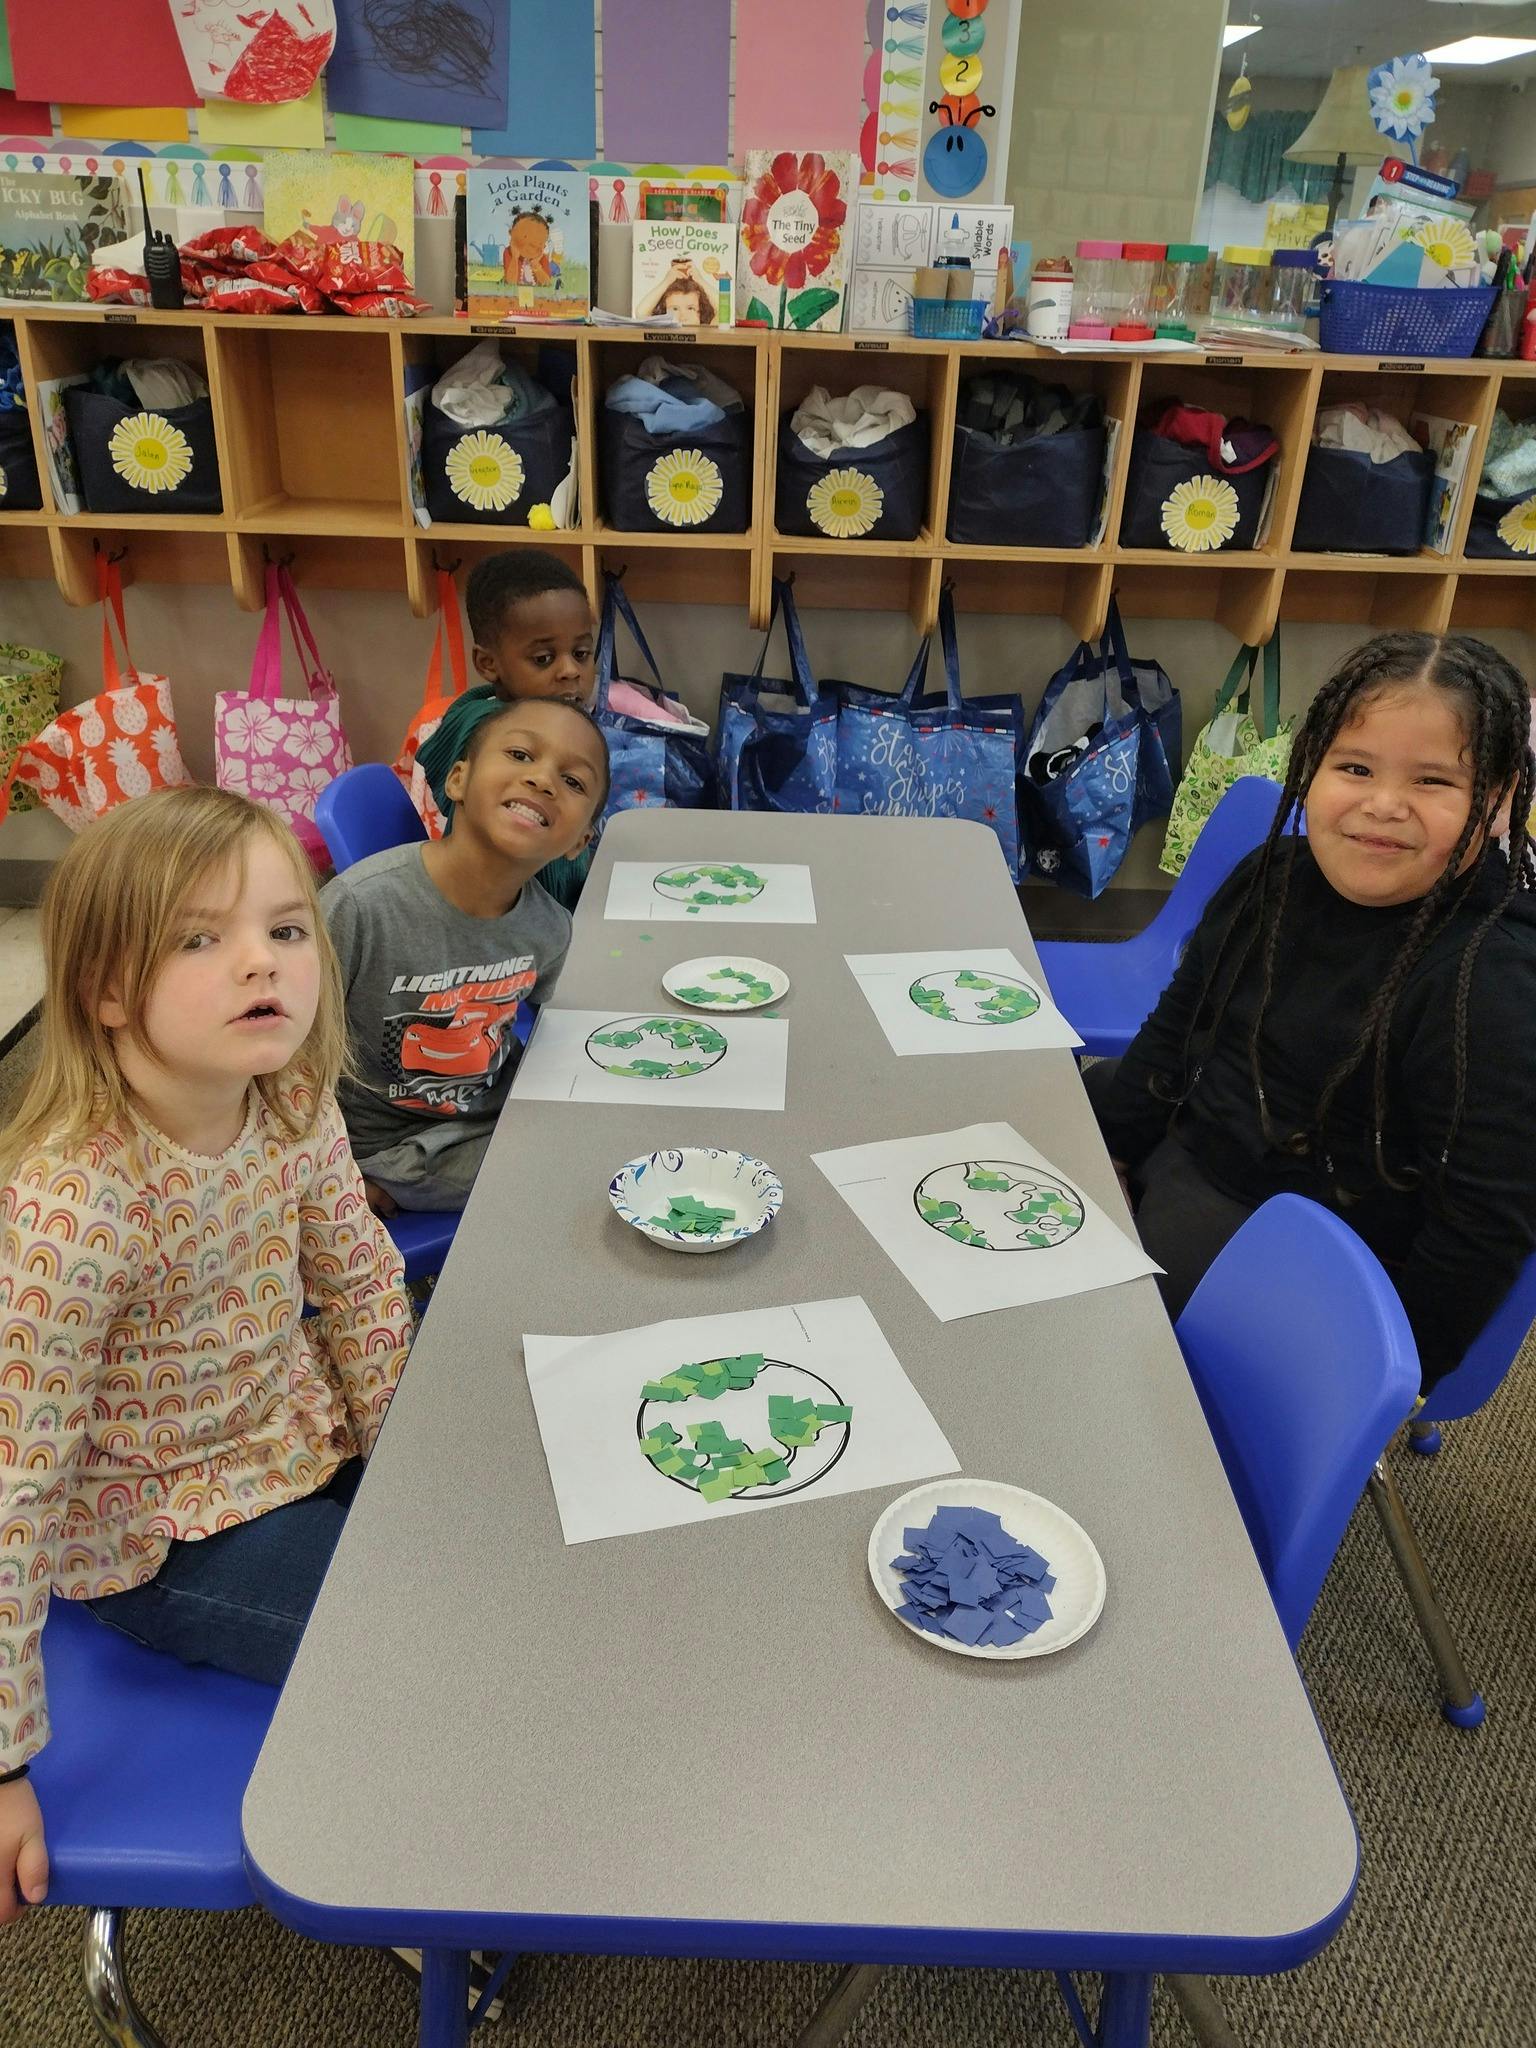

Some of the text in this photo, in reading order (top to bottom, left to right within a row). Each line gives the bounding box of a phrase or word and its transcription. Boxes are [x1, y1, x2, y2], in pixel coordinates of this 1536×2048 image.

[958, 20, 971, 43] 3
[956, 60, 969, 82] 2
[1390, 166, 1398, 178] 1
[487, 175, 569, 197] Lola Plants
[1, 188, 84, 206] ICKY BUG
[494, 190, 560, 207] a Garden
[15, 210, 79, 221] Alphabet Book
[651, 226, 718, 240] How Does
[772, 220, 816, 234] The Tiny
[639, 243, 646, 252] a
[687, 239, 729, 254] Grow?
[782, 233, 806, 243] Seed
[972, 220, 984, 260] Syllable
[983, 223, 994, 257] Words
[1188, 503, 1216, 520] Roman
[871, 723, 929, 776] Stas
[389, 955, 535, 994] LIGHTNING
